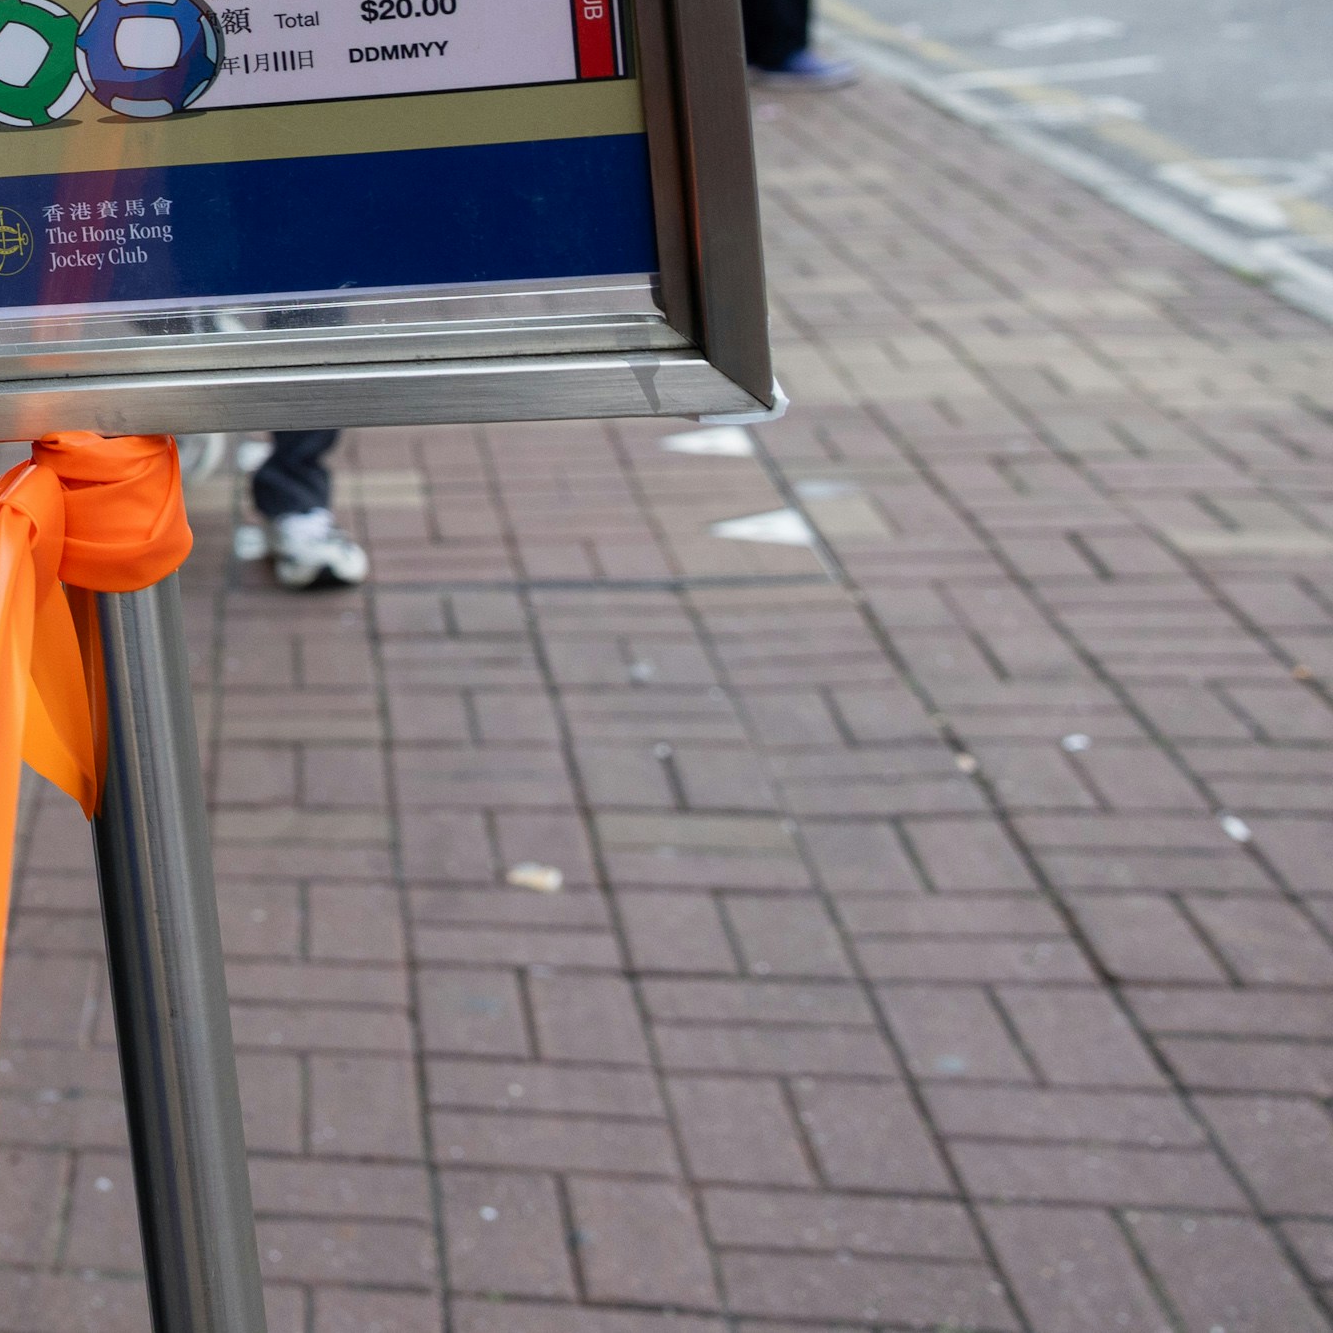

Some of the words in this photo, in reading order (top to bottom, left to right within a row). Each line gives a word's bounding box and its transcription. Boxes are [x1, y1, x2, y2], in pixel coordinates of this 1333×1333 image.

[274, 11, 320, 29] Total
[349, 40, 449, 63] DDMMYY
[42, 196, 173, 222] 香港賽馬會
[46, 226, 77, 245] The
[82, 226, 126, 245] Hong
[129, 223, 173, 243] Kong
[49, 249, 105, 272] Jockey
[109, 246, 148, 265] Club
